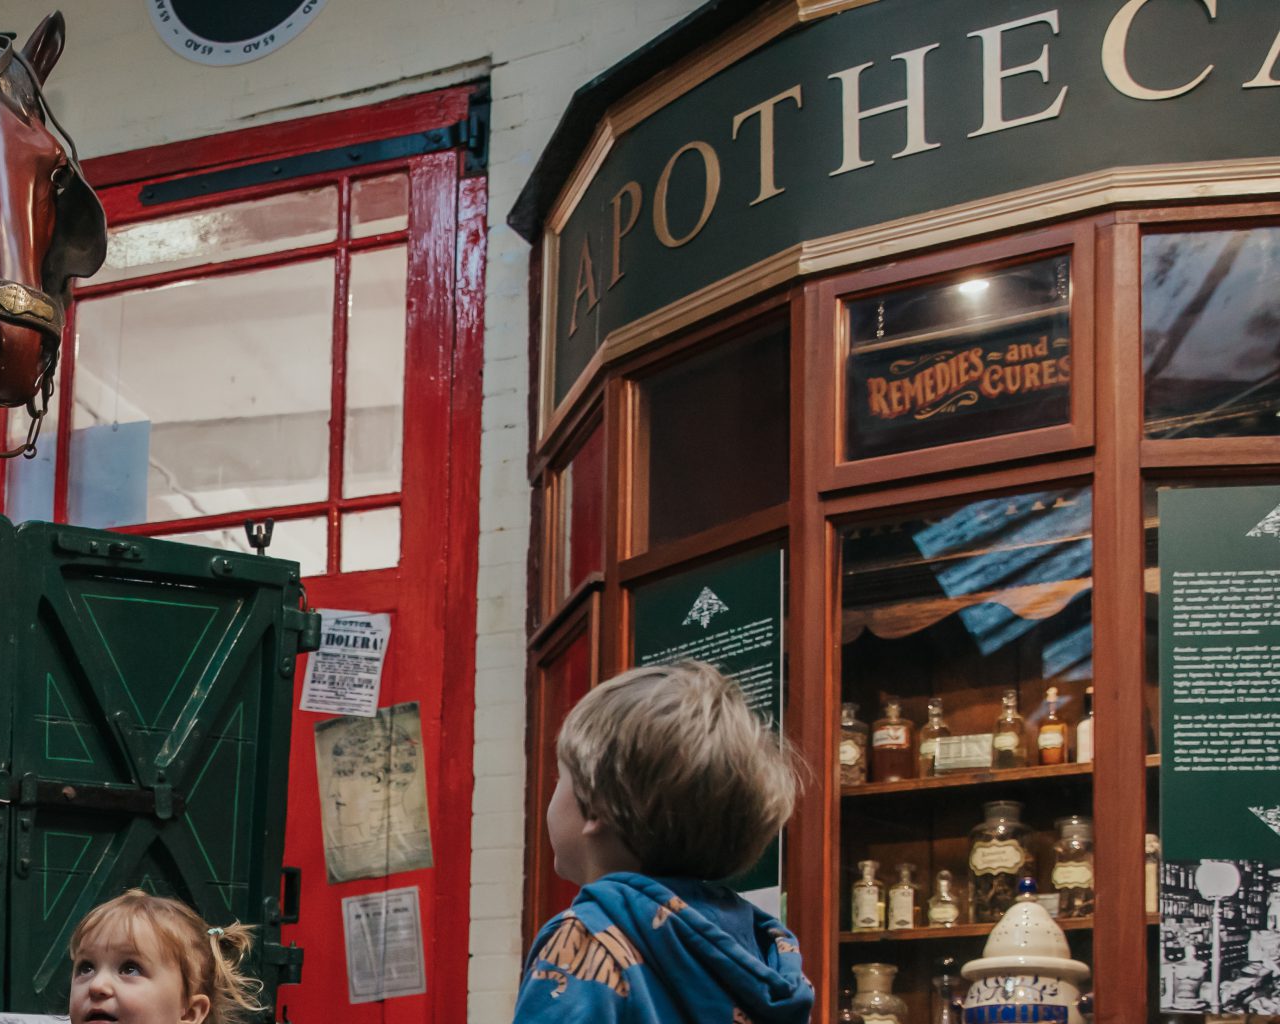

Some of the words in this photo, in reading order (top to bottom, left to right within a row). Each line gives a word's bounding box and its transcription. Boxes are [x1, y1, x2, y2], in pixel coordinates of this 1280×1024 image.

[568, 0, 1280, 339] APOTHEC
[867, 348, 984, 419] REMEDIES
[1006, 336, 1048, 362] and
[979, 355, 1070, 398] CURES
[320, 633, 383, 651] HOLERA!
